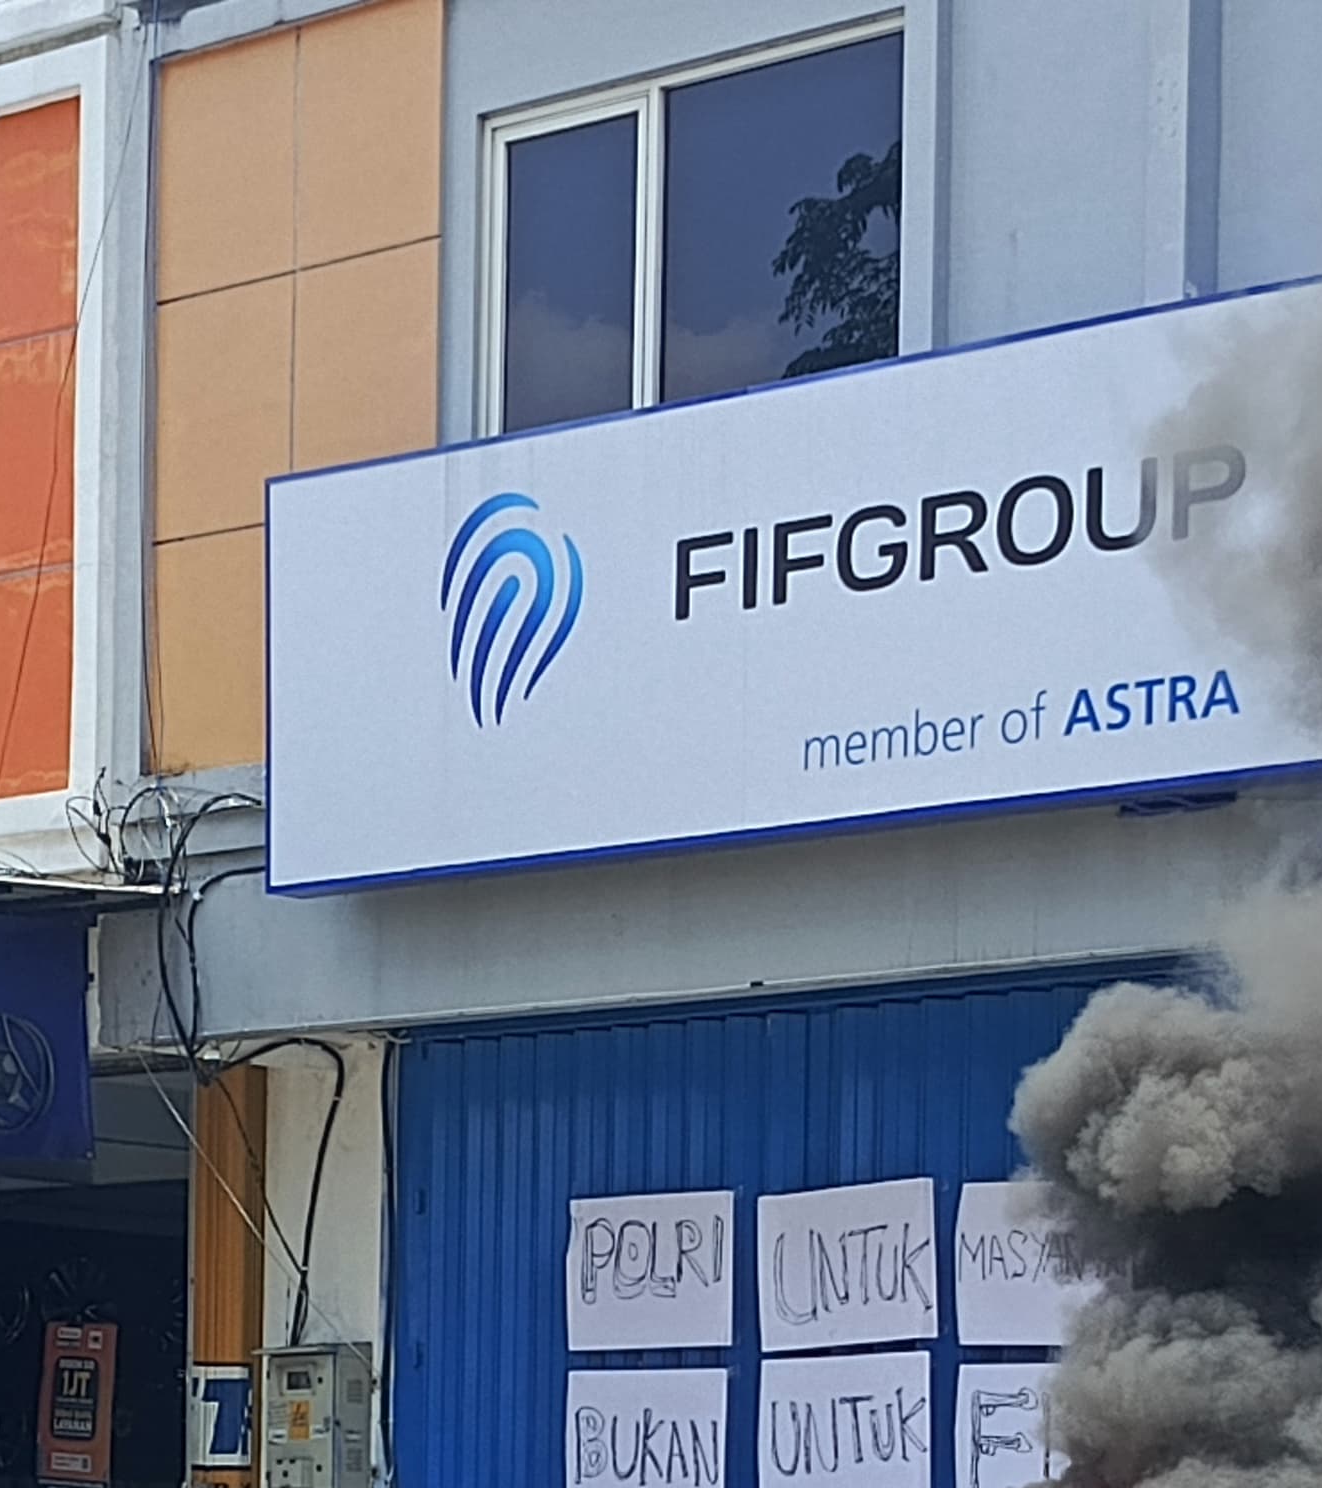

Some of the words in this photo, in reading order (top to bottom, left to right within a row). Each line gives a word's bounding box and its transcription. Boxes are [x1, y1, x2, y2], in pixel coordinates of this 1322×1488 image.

[675, 444, 1247, 621] FIFGROUP
[803, 709, 984, 770] member
[1001, 690, 1048, 744] of
[1063, 669, 1240, 736] ASTRA
[581, 1216, 724, 1304] POLRI
[773, 1223, 933, 1325] UNTUK
[575, 1405, 720, 1488] BUKAN
[771, 1387, 927, 1477] UNTUK
